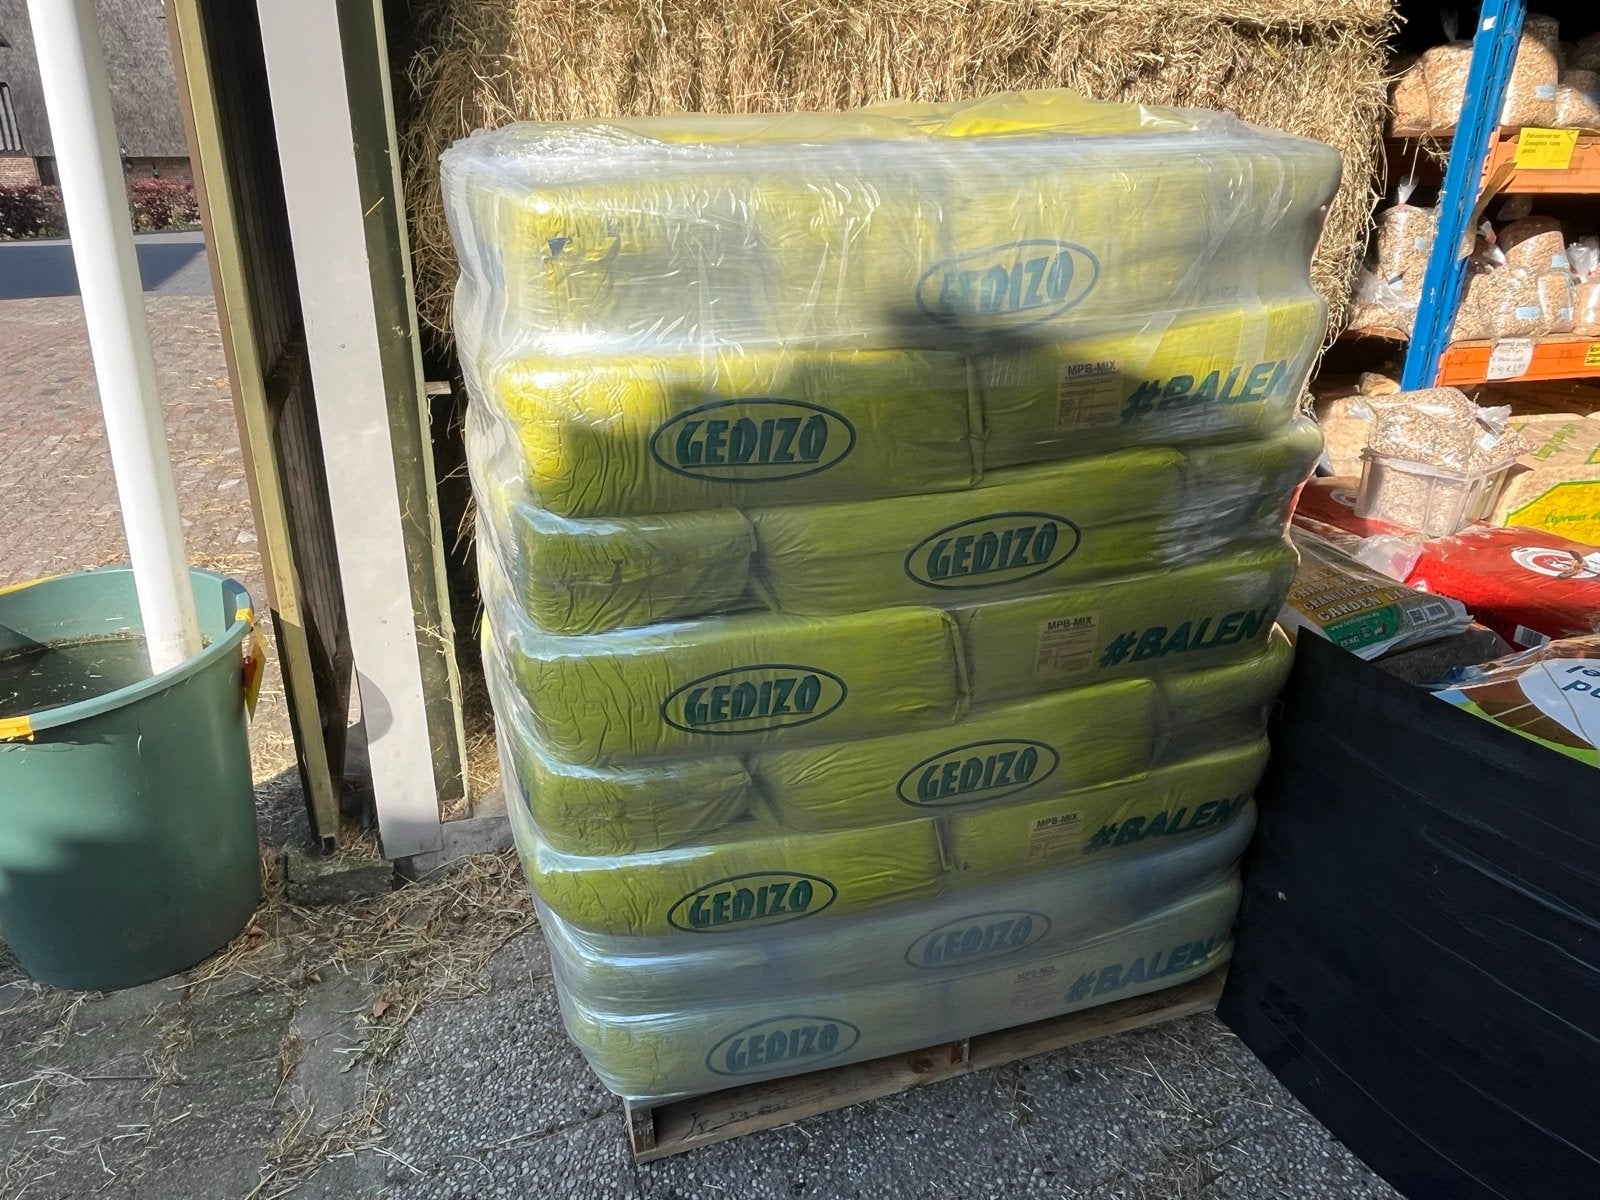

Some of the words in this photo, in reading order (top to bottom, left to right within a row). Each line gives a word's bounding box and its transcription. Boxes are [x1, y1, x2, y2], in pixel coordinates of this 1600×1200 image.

[1068, 361, 1116, 376] MPB-MIX
[1120, 355, 1300, 424] #BALEN
[676, 414, 829, 466] GEDIZO
[926, 522, 1058, 580] GEDIZO
[1048, 616, 1093, 630] MPB-MIX
[1317, 596, 1382, 621] GARDEN
[1098, 608, 1269, 668] #BALEN
[684, 675, 821, 726] GEDIZO
[917, 746, 1038, 802] GEDIZO
[1036, 813, 1079, 829] MPB-MIX
[1081, 793, 1242, 855] #BALEN
[688, 880, 814, 929] GEDIZO
[923, 915, 1033, 963] GEDIZO
[1063, 935, 1217, 1003] #BALEN
[725, 1023, 840, 1072] GEDIZO
